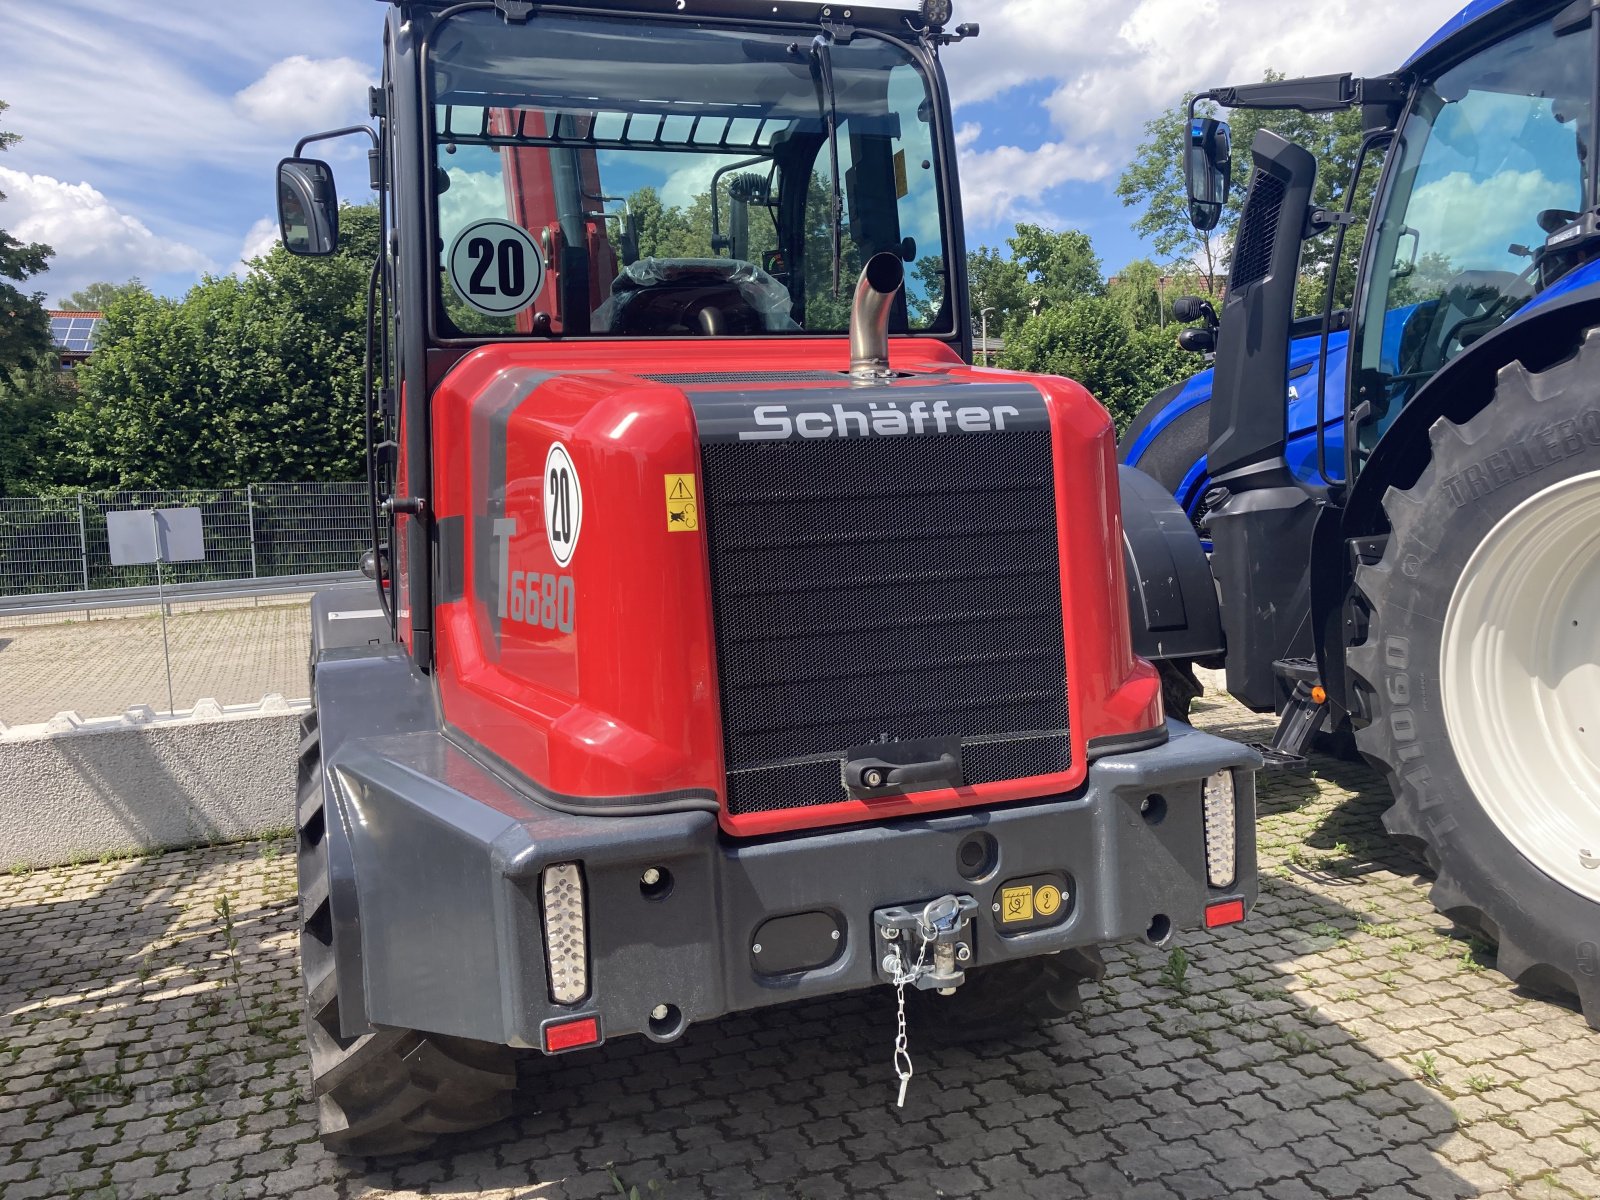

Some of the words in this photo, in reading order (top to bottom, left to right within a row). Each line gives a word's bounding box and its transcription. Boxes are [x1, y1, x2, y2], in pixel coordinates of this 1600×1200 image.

[468, 237, 525, 297] 20
[738, 400, 1020, 441] Schäffer
[550, 466, 571, 544] 20
